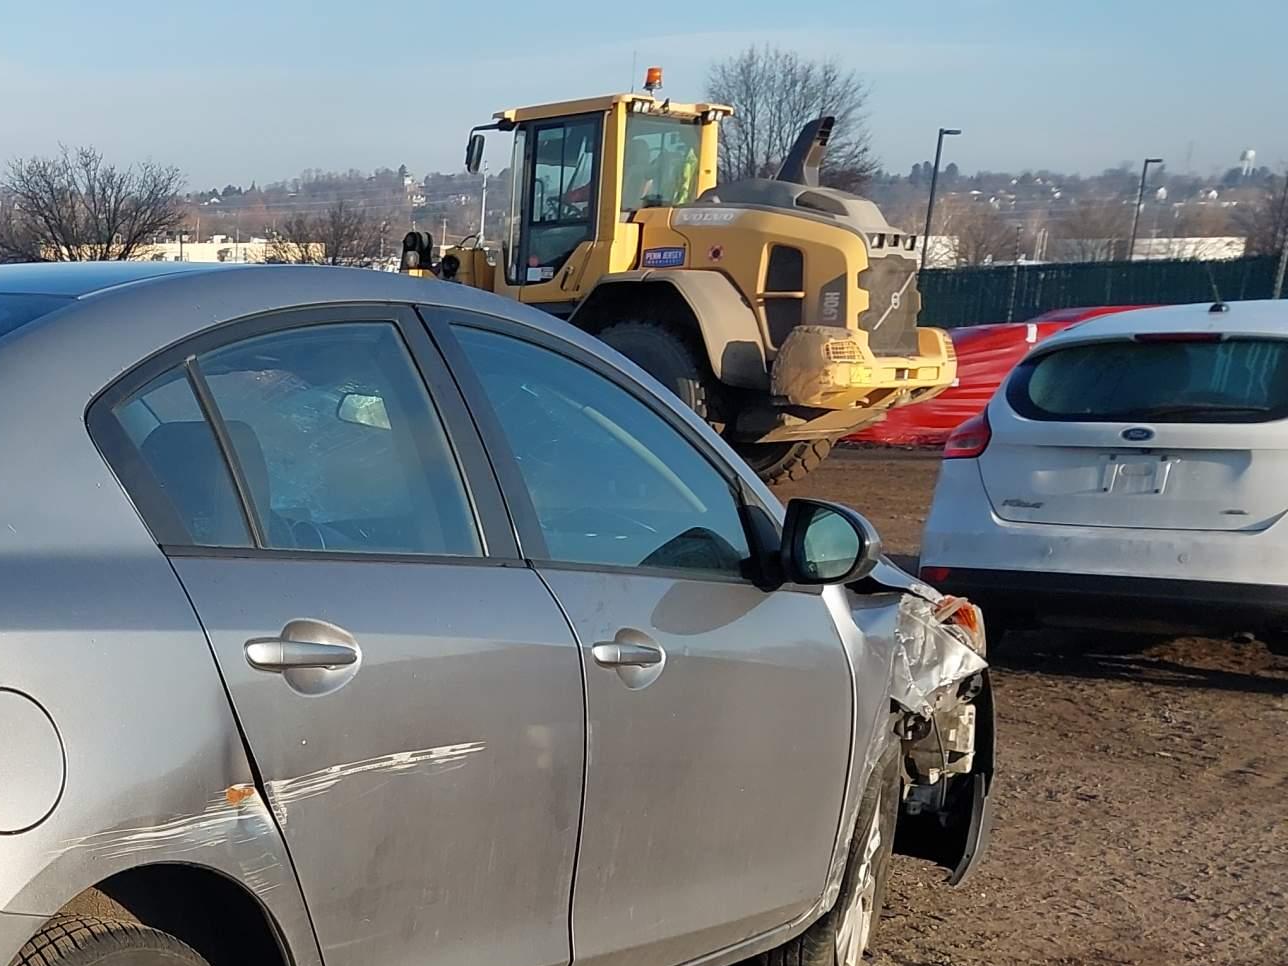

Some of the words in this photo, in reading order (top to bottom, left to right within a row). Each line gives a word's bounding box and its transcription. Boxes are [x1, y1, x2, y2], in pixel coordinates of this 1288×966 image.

[681, 212, 735, 221] VOLVO
[645, 251, 662, 261] PENN
[662, 250, 682, 260] JERSEY
[823, 292, 840, 321] L90H
